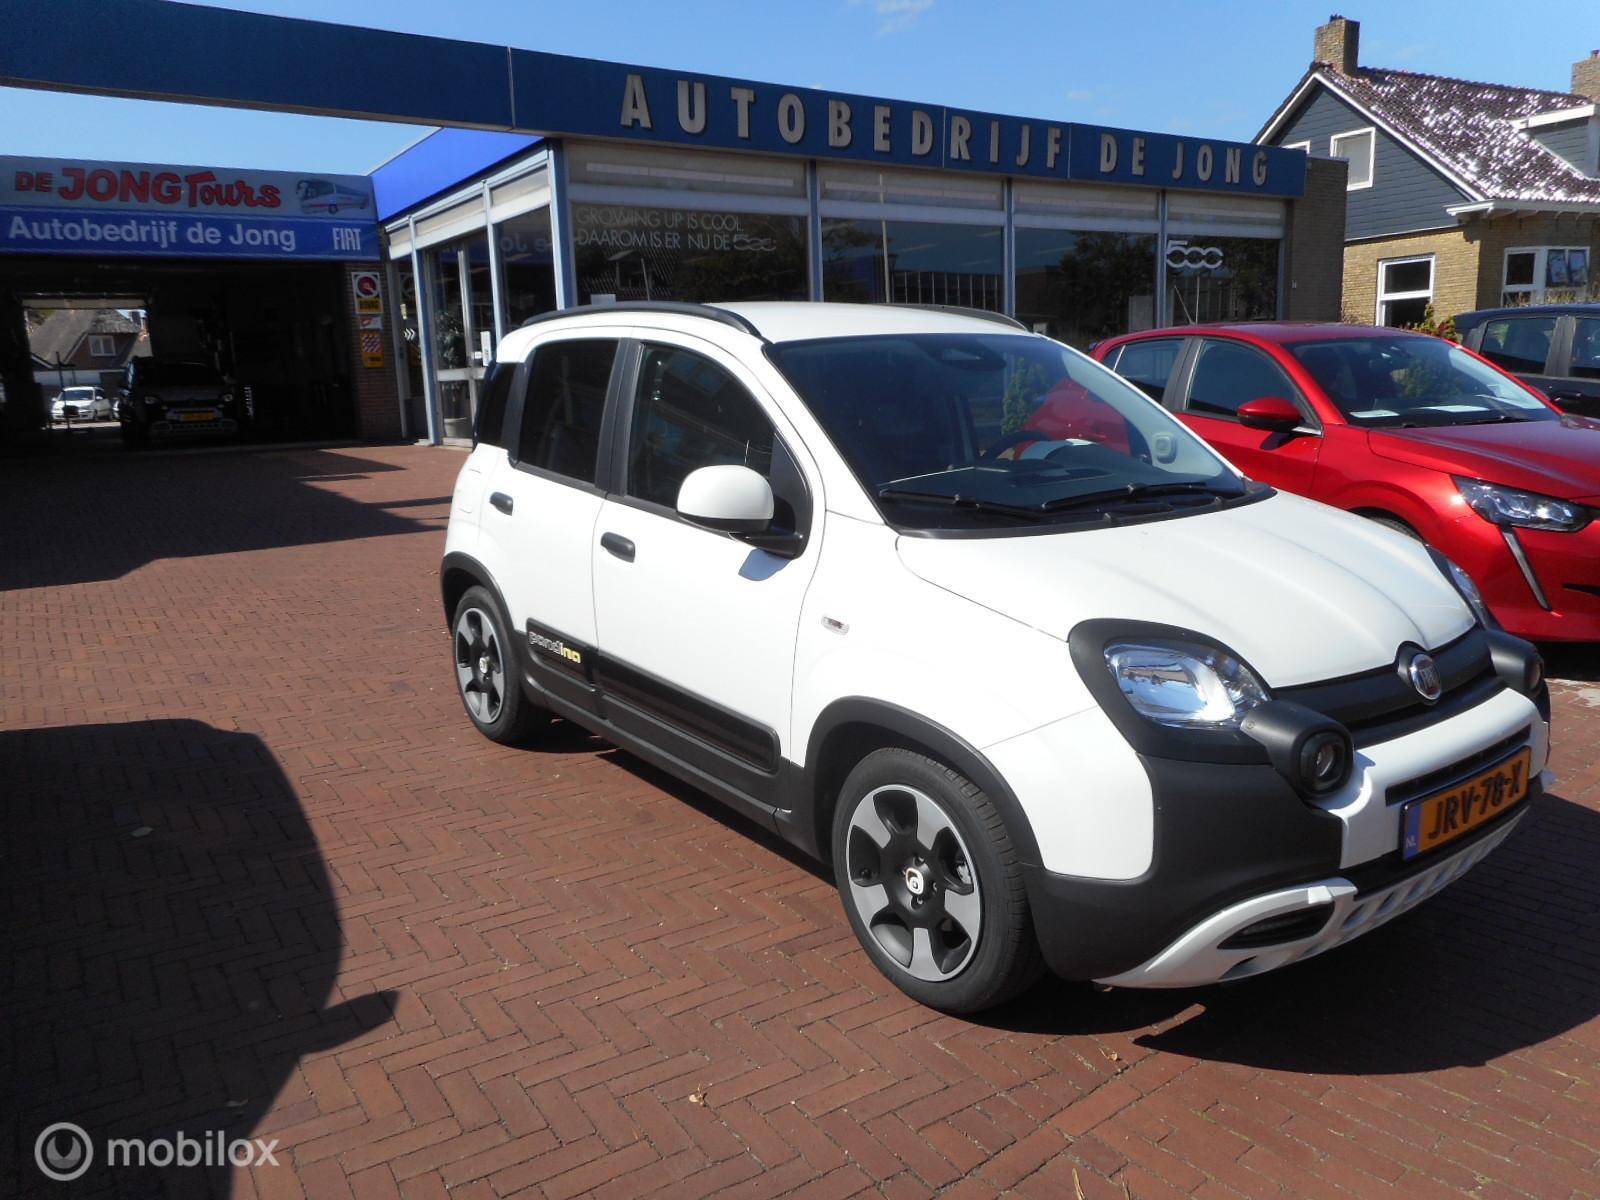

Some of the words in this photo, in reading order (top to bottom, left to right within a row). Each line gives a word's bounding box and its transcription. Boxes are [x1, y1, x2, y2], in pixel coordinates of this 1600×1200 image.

[620, 74, 1062, 169] AUTOBEDRIJF
[1100, 133, 1145, 176] DE
[1172, 142, 1268, 186] JONG
[15, 170, 53, 192] DE
[58, 167, 182, 205] JONG
[186, 170, 281, 208] Tours
[8, 215, 178, 248] Autobedrijf
[186, 221, 221, 244] de
[229, 223, 296, 251] Jong
[575, 207, 660, 227] GROWING
[665, 211, 684, 228] UP
[688, 213, 698, 229] IS
[332, 227, 361, 250] FIAT
[576, 229, 646, 248] DAAROM
[648, 231, 662, 248] IS
[665, 232, 681, 248] ER
[688, 233, 710, 249] NU
[713, 234, 731, 250] DE
[1427, 759, 1523, 840] JRV-78-X
